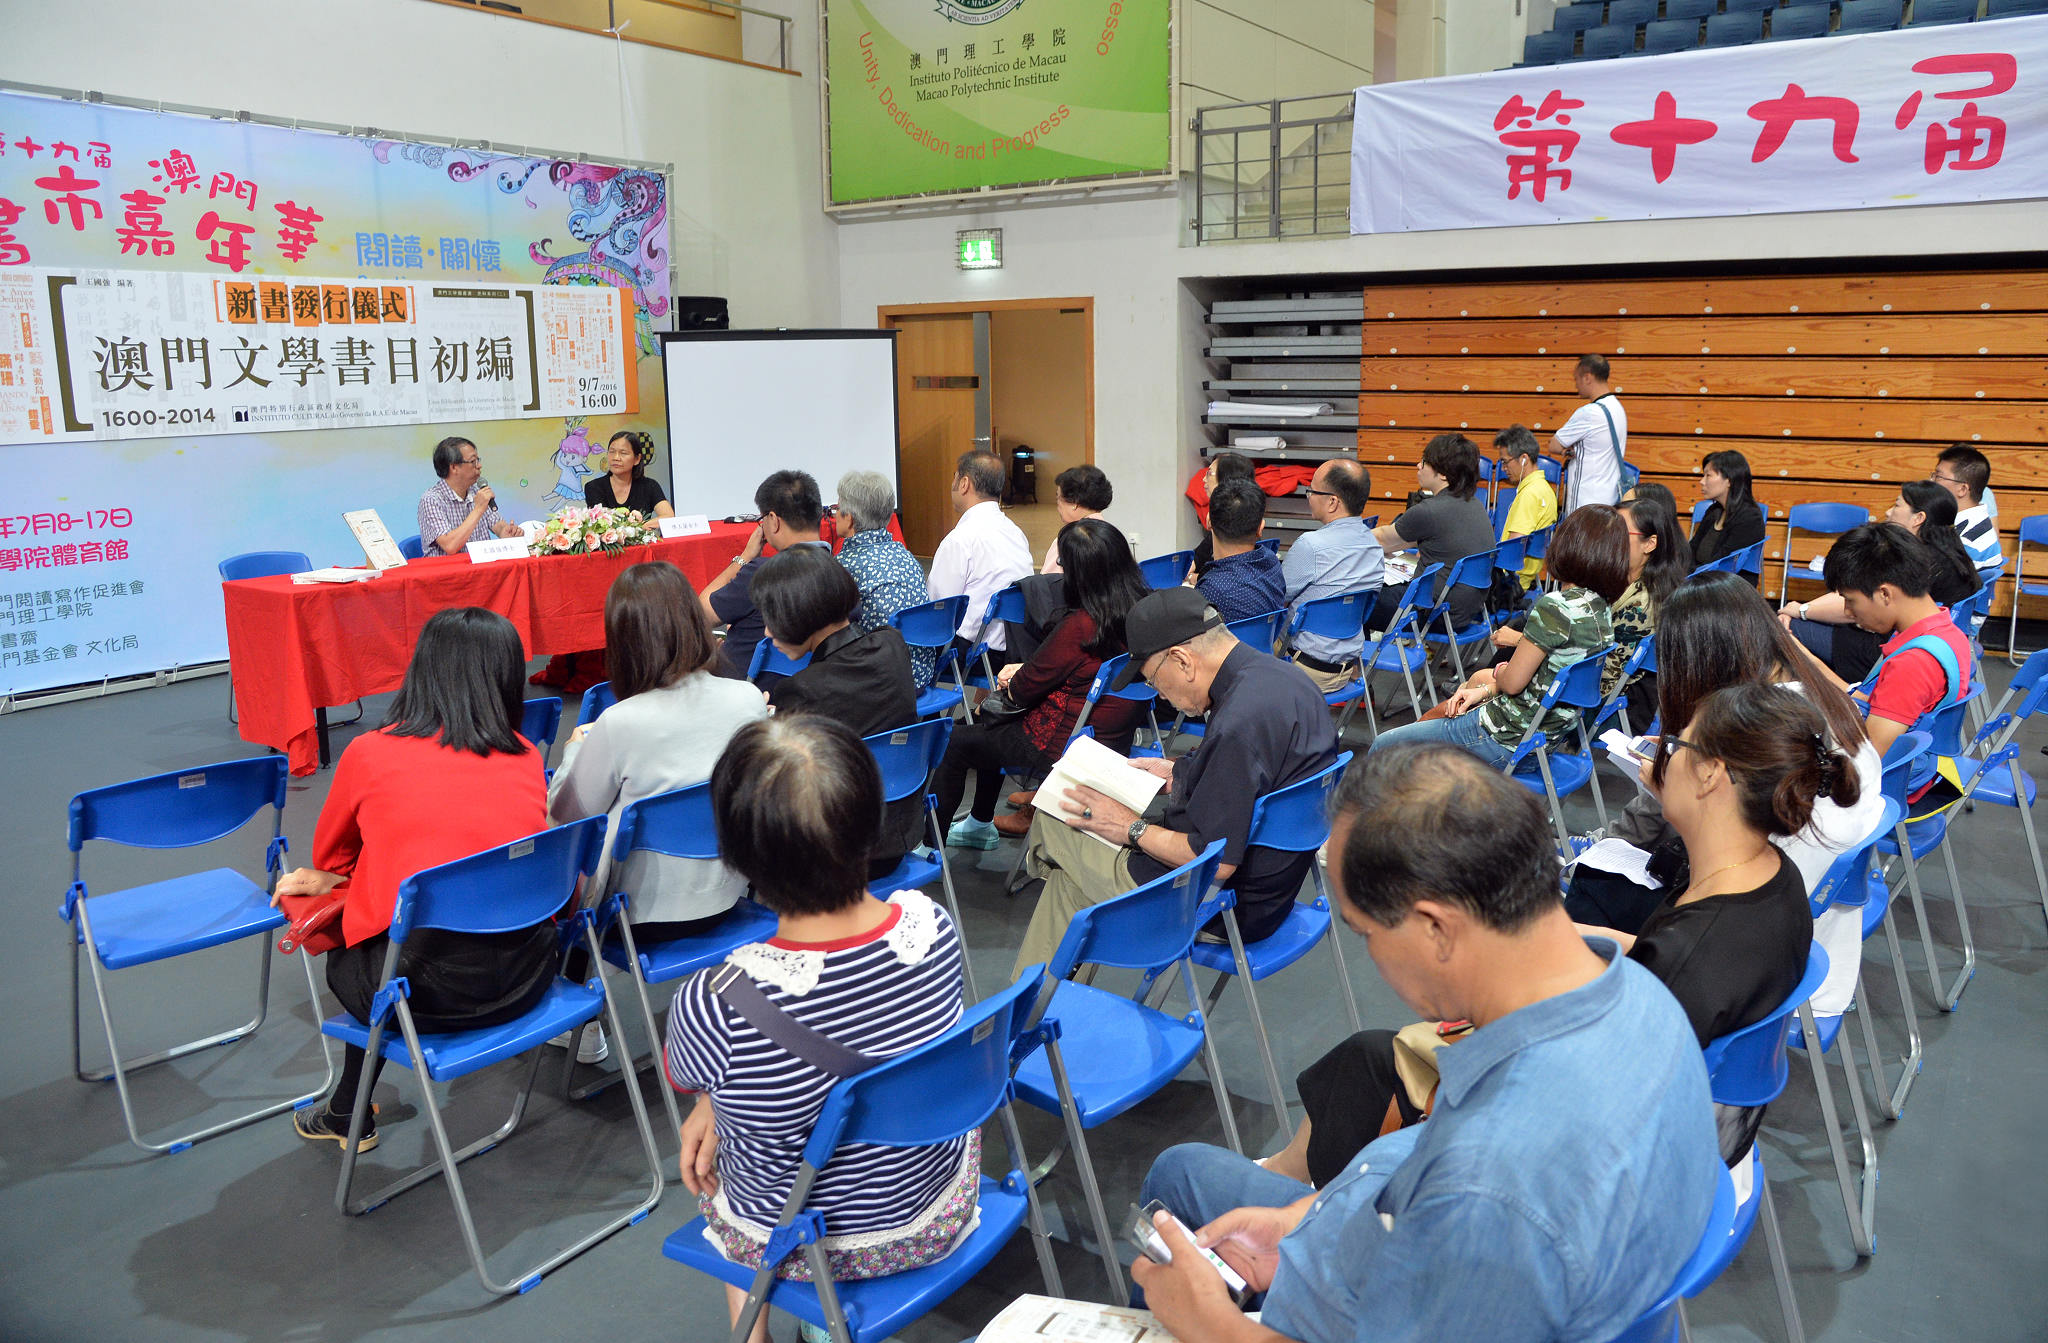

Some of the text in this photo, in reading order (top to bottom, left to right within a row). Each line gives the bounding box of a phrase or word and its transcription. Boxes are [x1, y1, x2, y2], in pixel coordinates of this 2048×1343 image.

[1097, 0, 1124, 56] esso
[910, 28, 1066, 70] 澳門理工學院
[910, 54, 1066, 87] Instituto Politécnico de Macau
[917, 71, 1060, 102] Macao Polytechnic Institute
[879, 85, 950, 157] Dedication
[954, 140, 985, 160] and
[992, 104, 1070, 158] Progress
[1493, 53, 2018, 203] 第十九屆
[148, 149, 257, 211] 澳門
[228, 286, 406, 320] 新書發行儀式
[92, 335, 514, 393] 澳門文學書目初編
[251, 400, 359, 413] 澳門特別行政區政府文化局
[252, 414, 290, 422] INSTITUTO
[291, 412, 328, 420] CULTURAL
[580, 393, 617, 408] 16:00
[102, 408, 216, 427] 1600-2014
[0, 539, 129, 571] 學院體育館
[0, 602, 94, 626] 門理工學院
[0, 635, 139, 668] 門基金會 文化局
